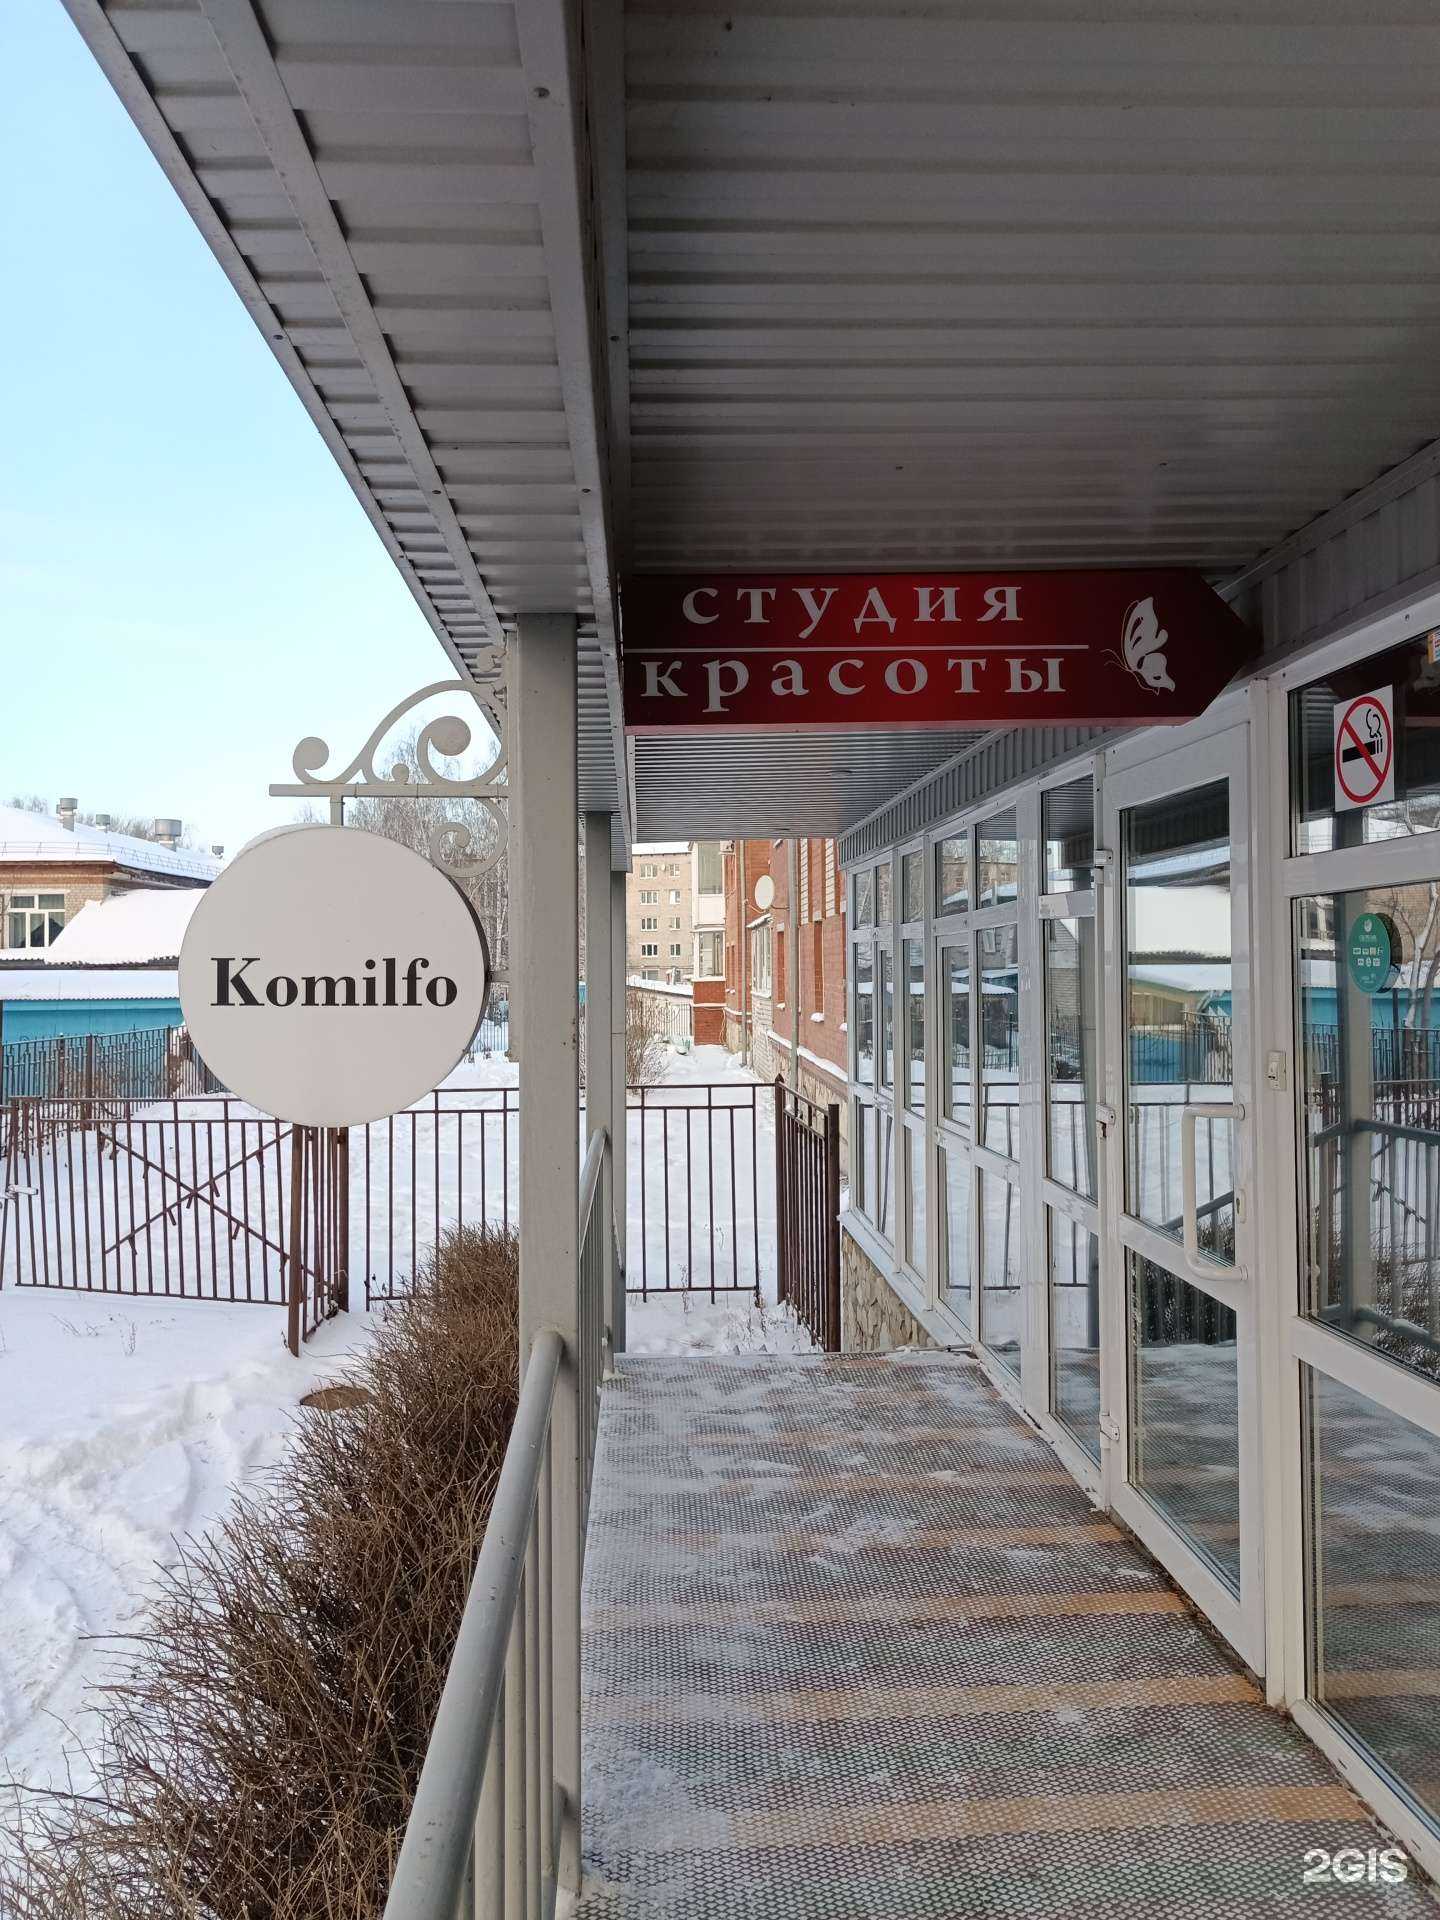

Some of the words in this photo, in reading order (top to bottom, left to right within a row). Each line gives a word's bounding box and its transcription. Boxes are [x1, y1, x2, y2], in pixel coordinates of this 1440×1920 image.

[682, 586, 1024, 639] студия
[640, 657, 1067, 713] красоты
[210, 957, 459, 1008] Komilfo
